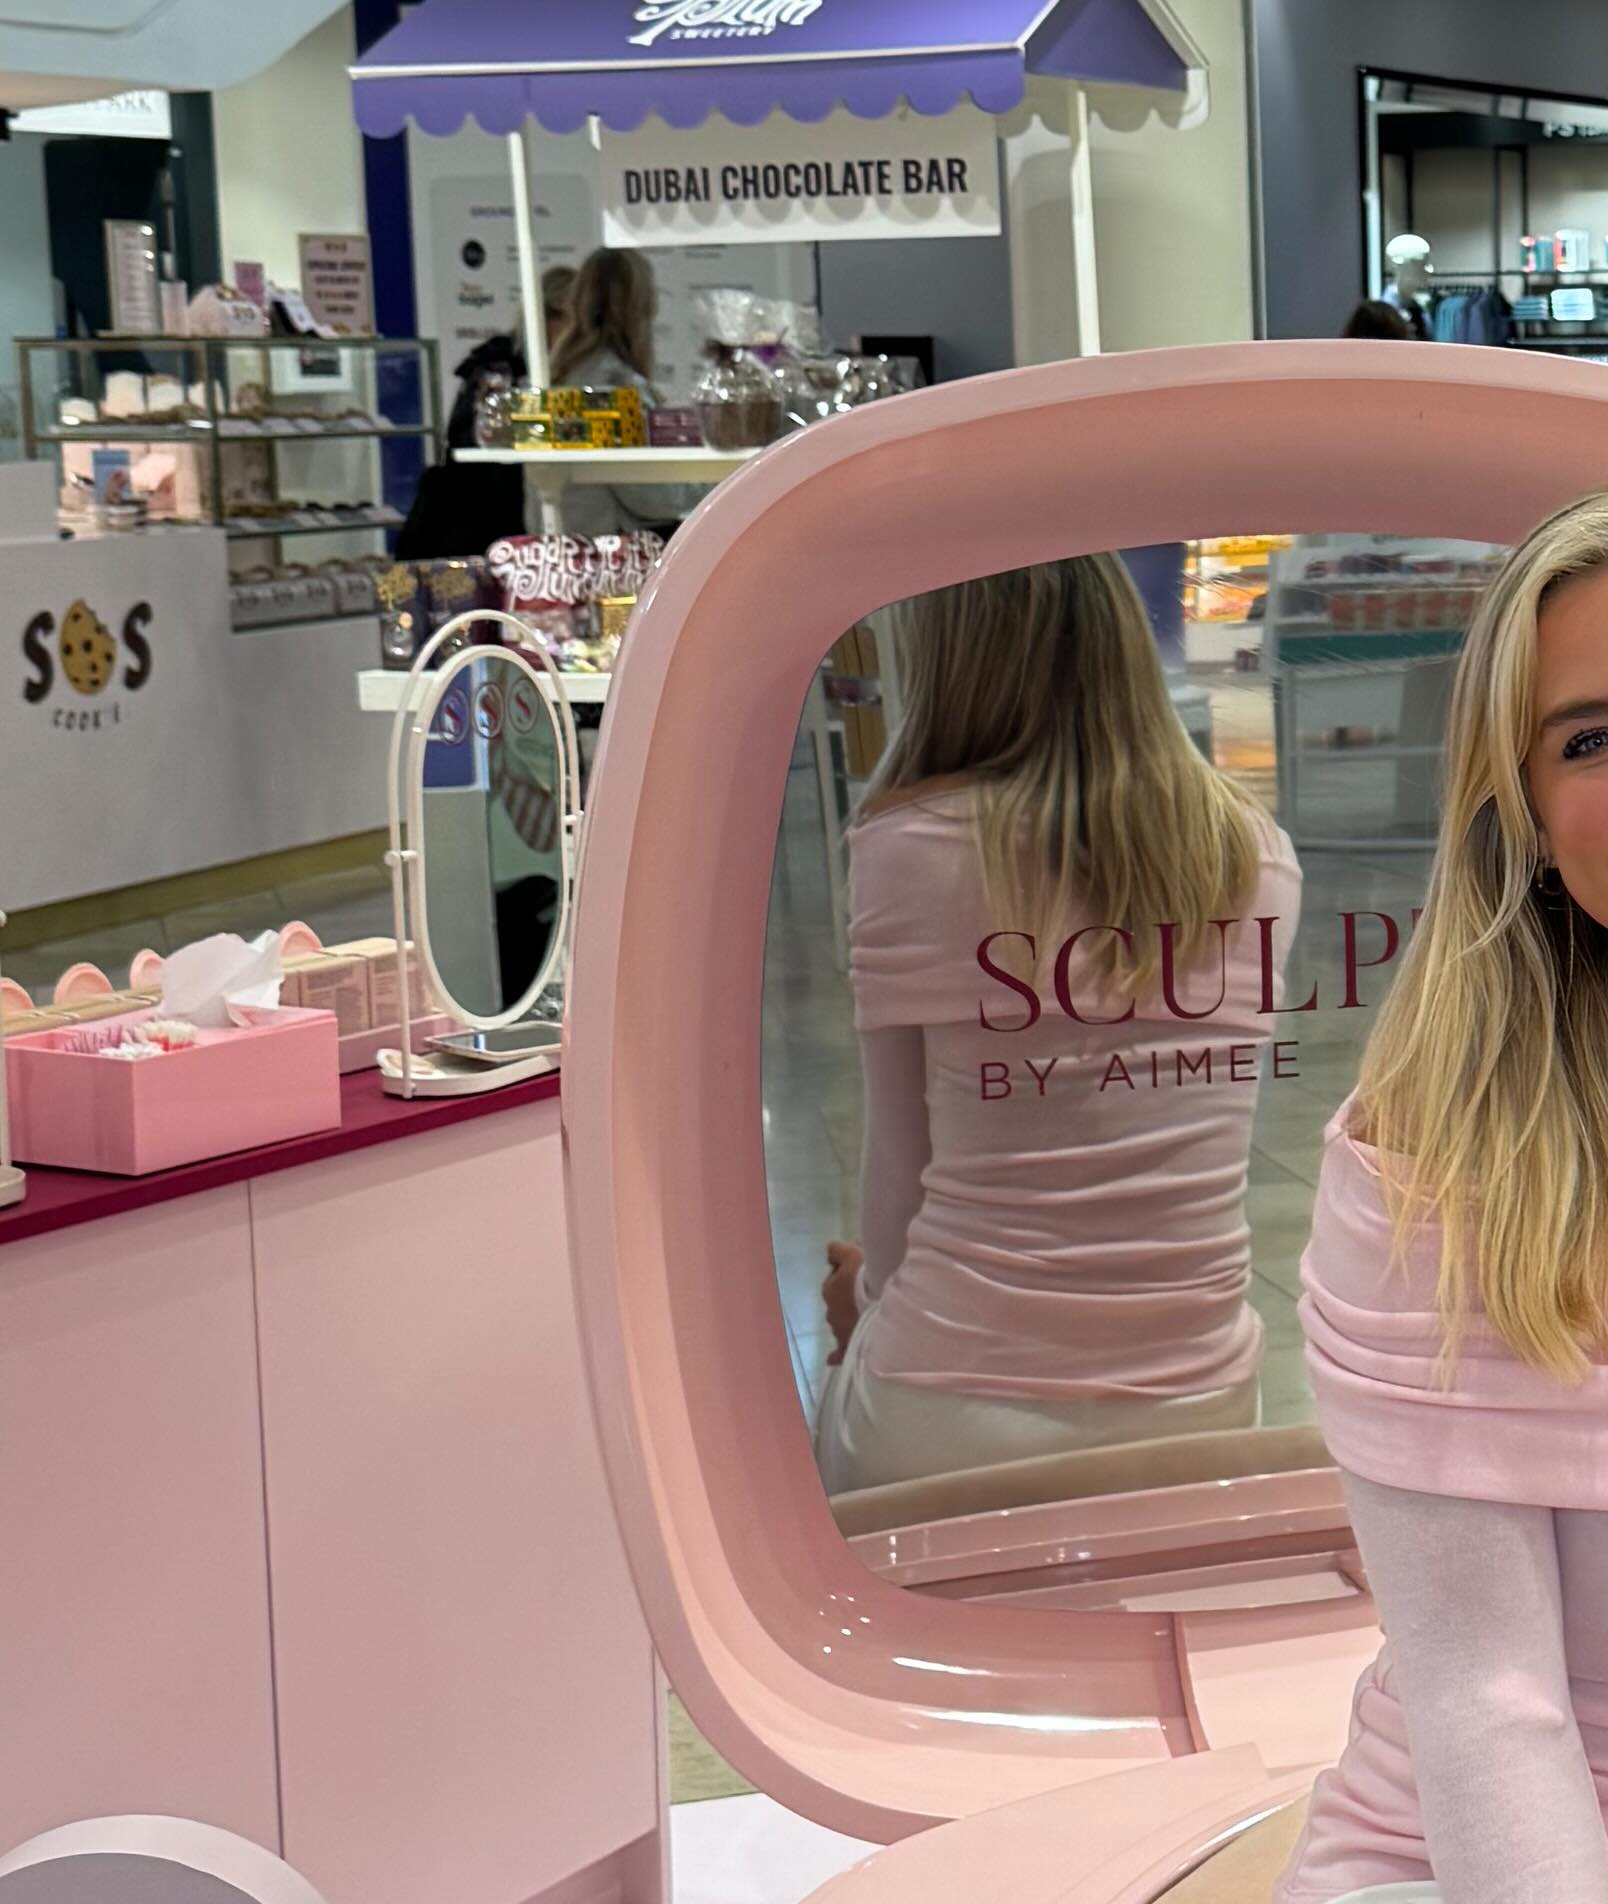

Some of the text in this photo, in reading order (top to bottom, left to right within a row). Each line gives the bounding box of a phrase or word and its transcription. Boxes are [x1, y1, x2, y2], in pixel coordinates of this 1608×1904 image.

[624, 157, 968, 204] DUBAI CHOCOLATE BAR
[975, 907, 1425, 1034] SCULP
[979, 1039, 1301, 1101] BY AIMEE
